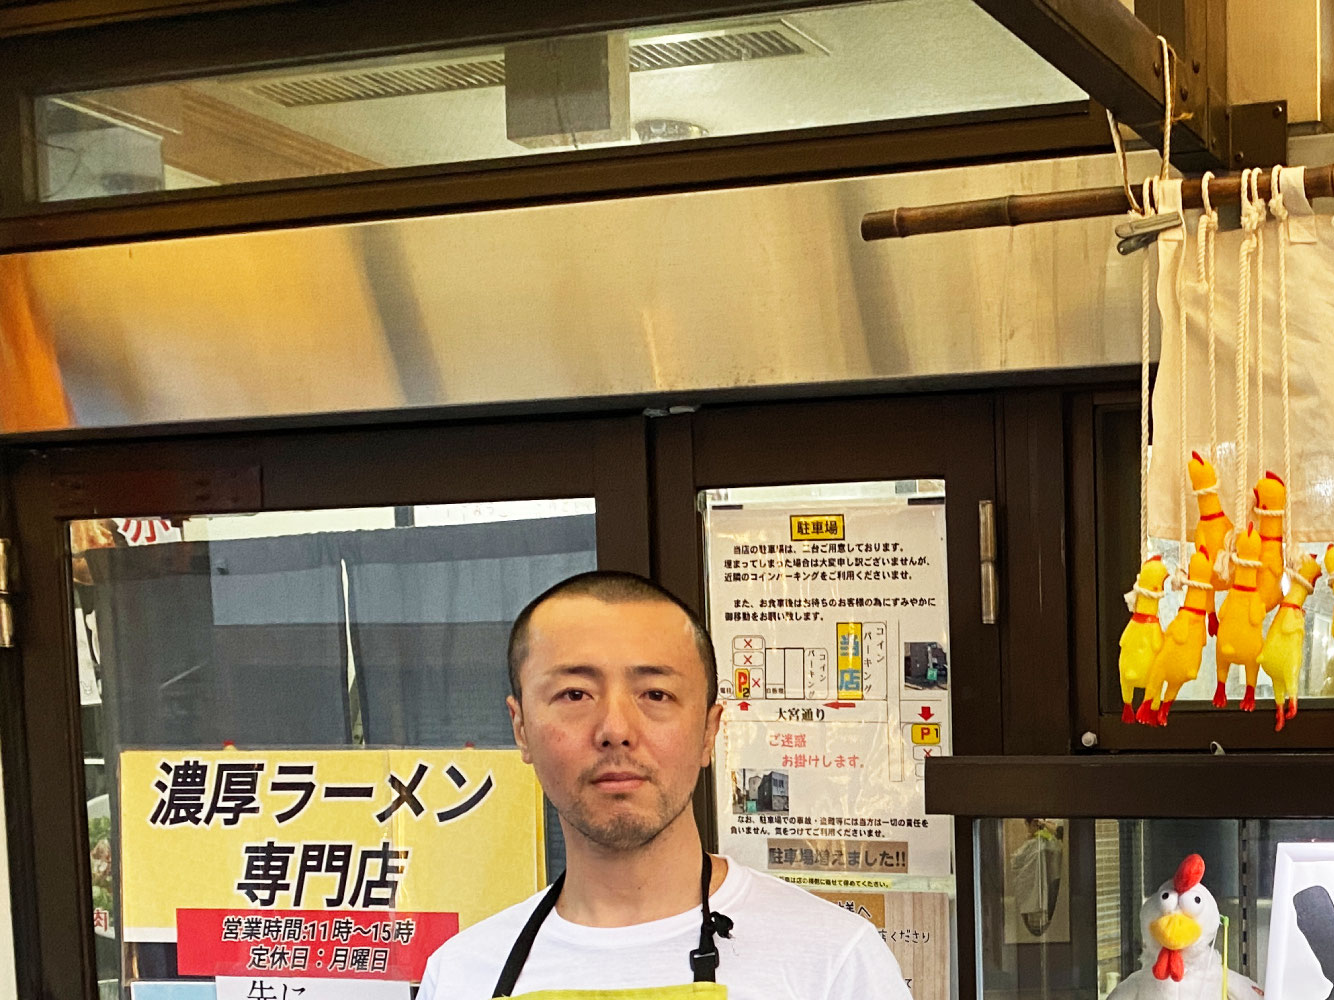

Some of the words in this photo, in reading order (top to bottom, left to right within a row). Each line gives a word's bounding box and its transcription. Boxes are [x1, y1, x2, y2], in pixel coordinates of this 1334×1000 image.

[796, 520, 838, 536] 駐車場
[725, 611, 824, 622] 御移動をお願い致します。
[777, 707, 825, 721] 大宮通り
[769, 733, 807, 748] ご迷惑
[782, 755, 865, 769] お掛けします。
[150, 760, 494, 826] 濃厚ラーメン
[768, 847, 906, 867] 駐車場増えました!!
[237, 841, 409, 909] 専門店
